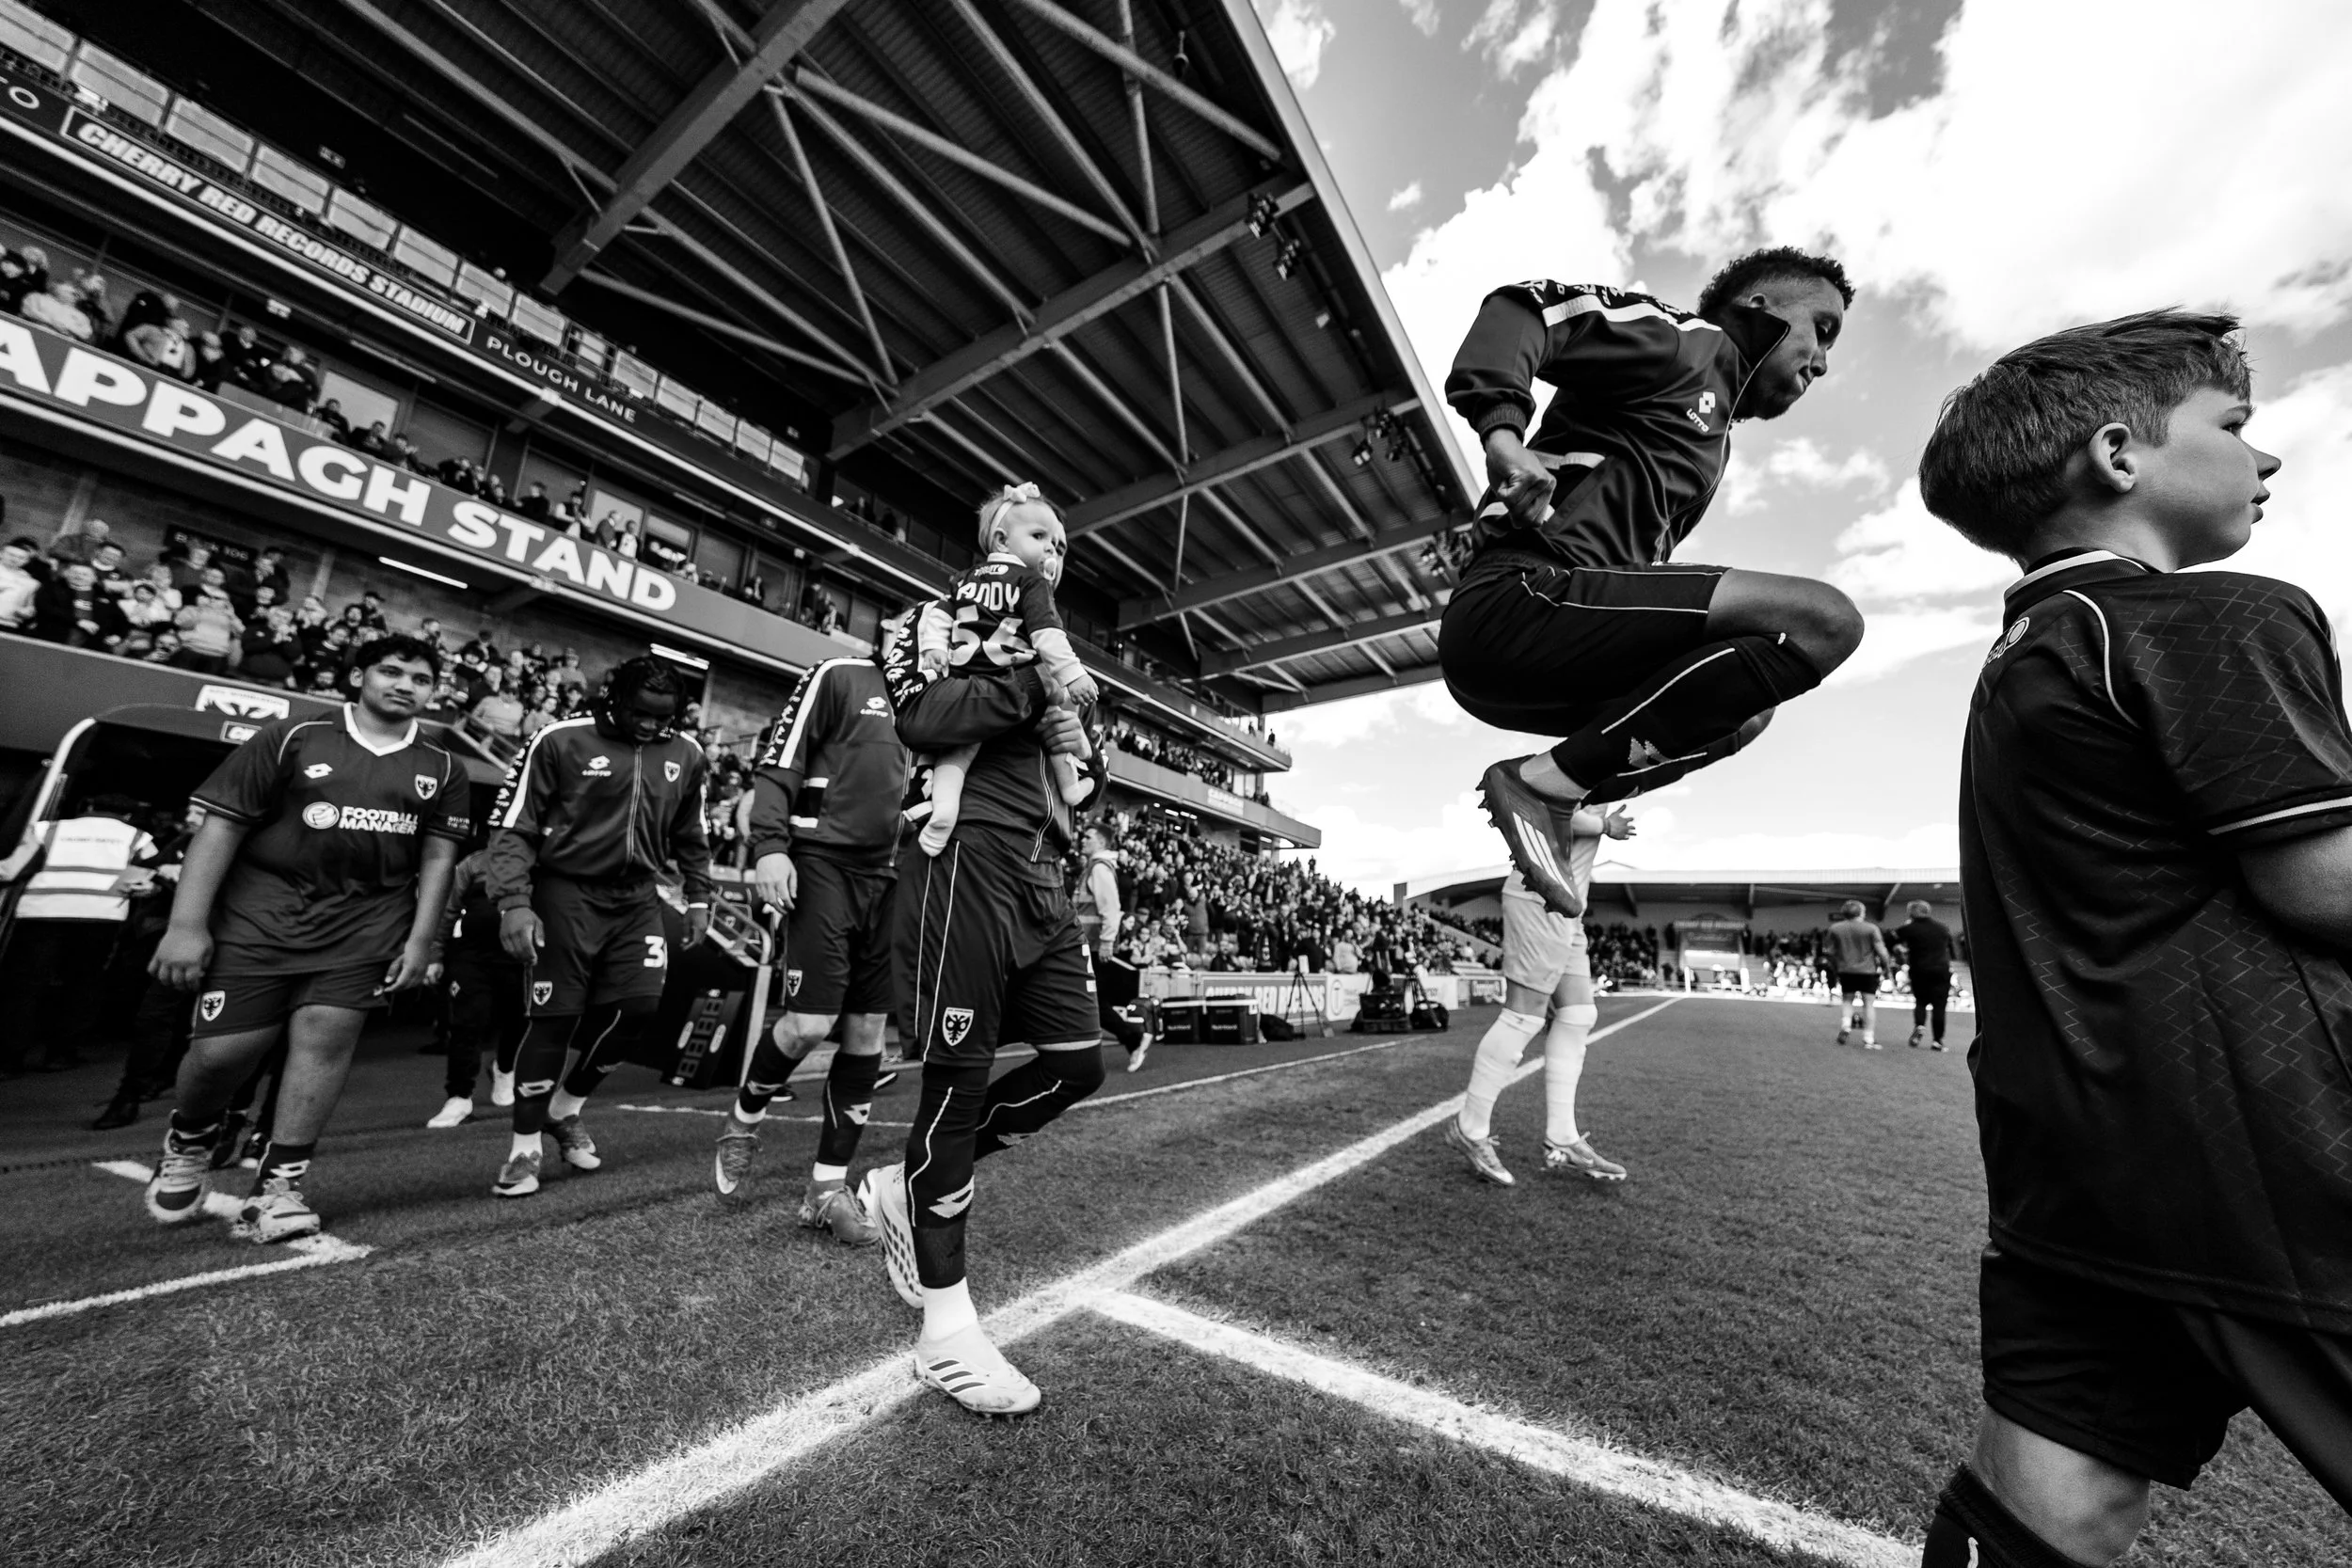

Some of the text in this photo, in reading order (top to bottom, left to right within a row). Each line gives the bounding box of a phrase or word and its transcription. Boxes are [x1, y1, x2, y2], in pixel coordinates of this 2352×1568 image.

[78, 122, 467, 335] CHERRY RED RECORDS STADIUM
[485, 335, 637, 423] PLOUGH LANE
[1686, 407, 1709, 433] LOTTO
[447, 500, 676, 611] STAND
[957, 578, 1021, 613] ANDY
[338, 816, 418, 835] MANAGER
[342, 805, 419, 825] FOOTBALL
[643, 935, 667, 969] 3
